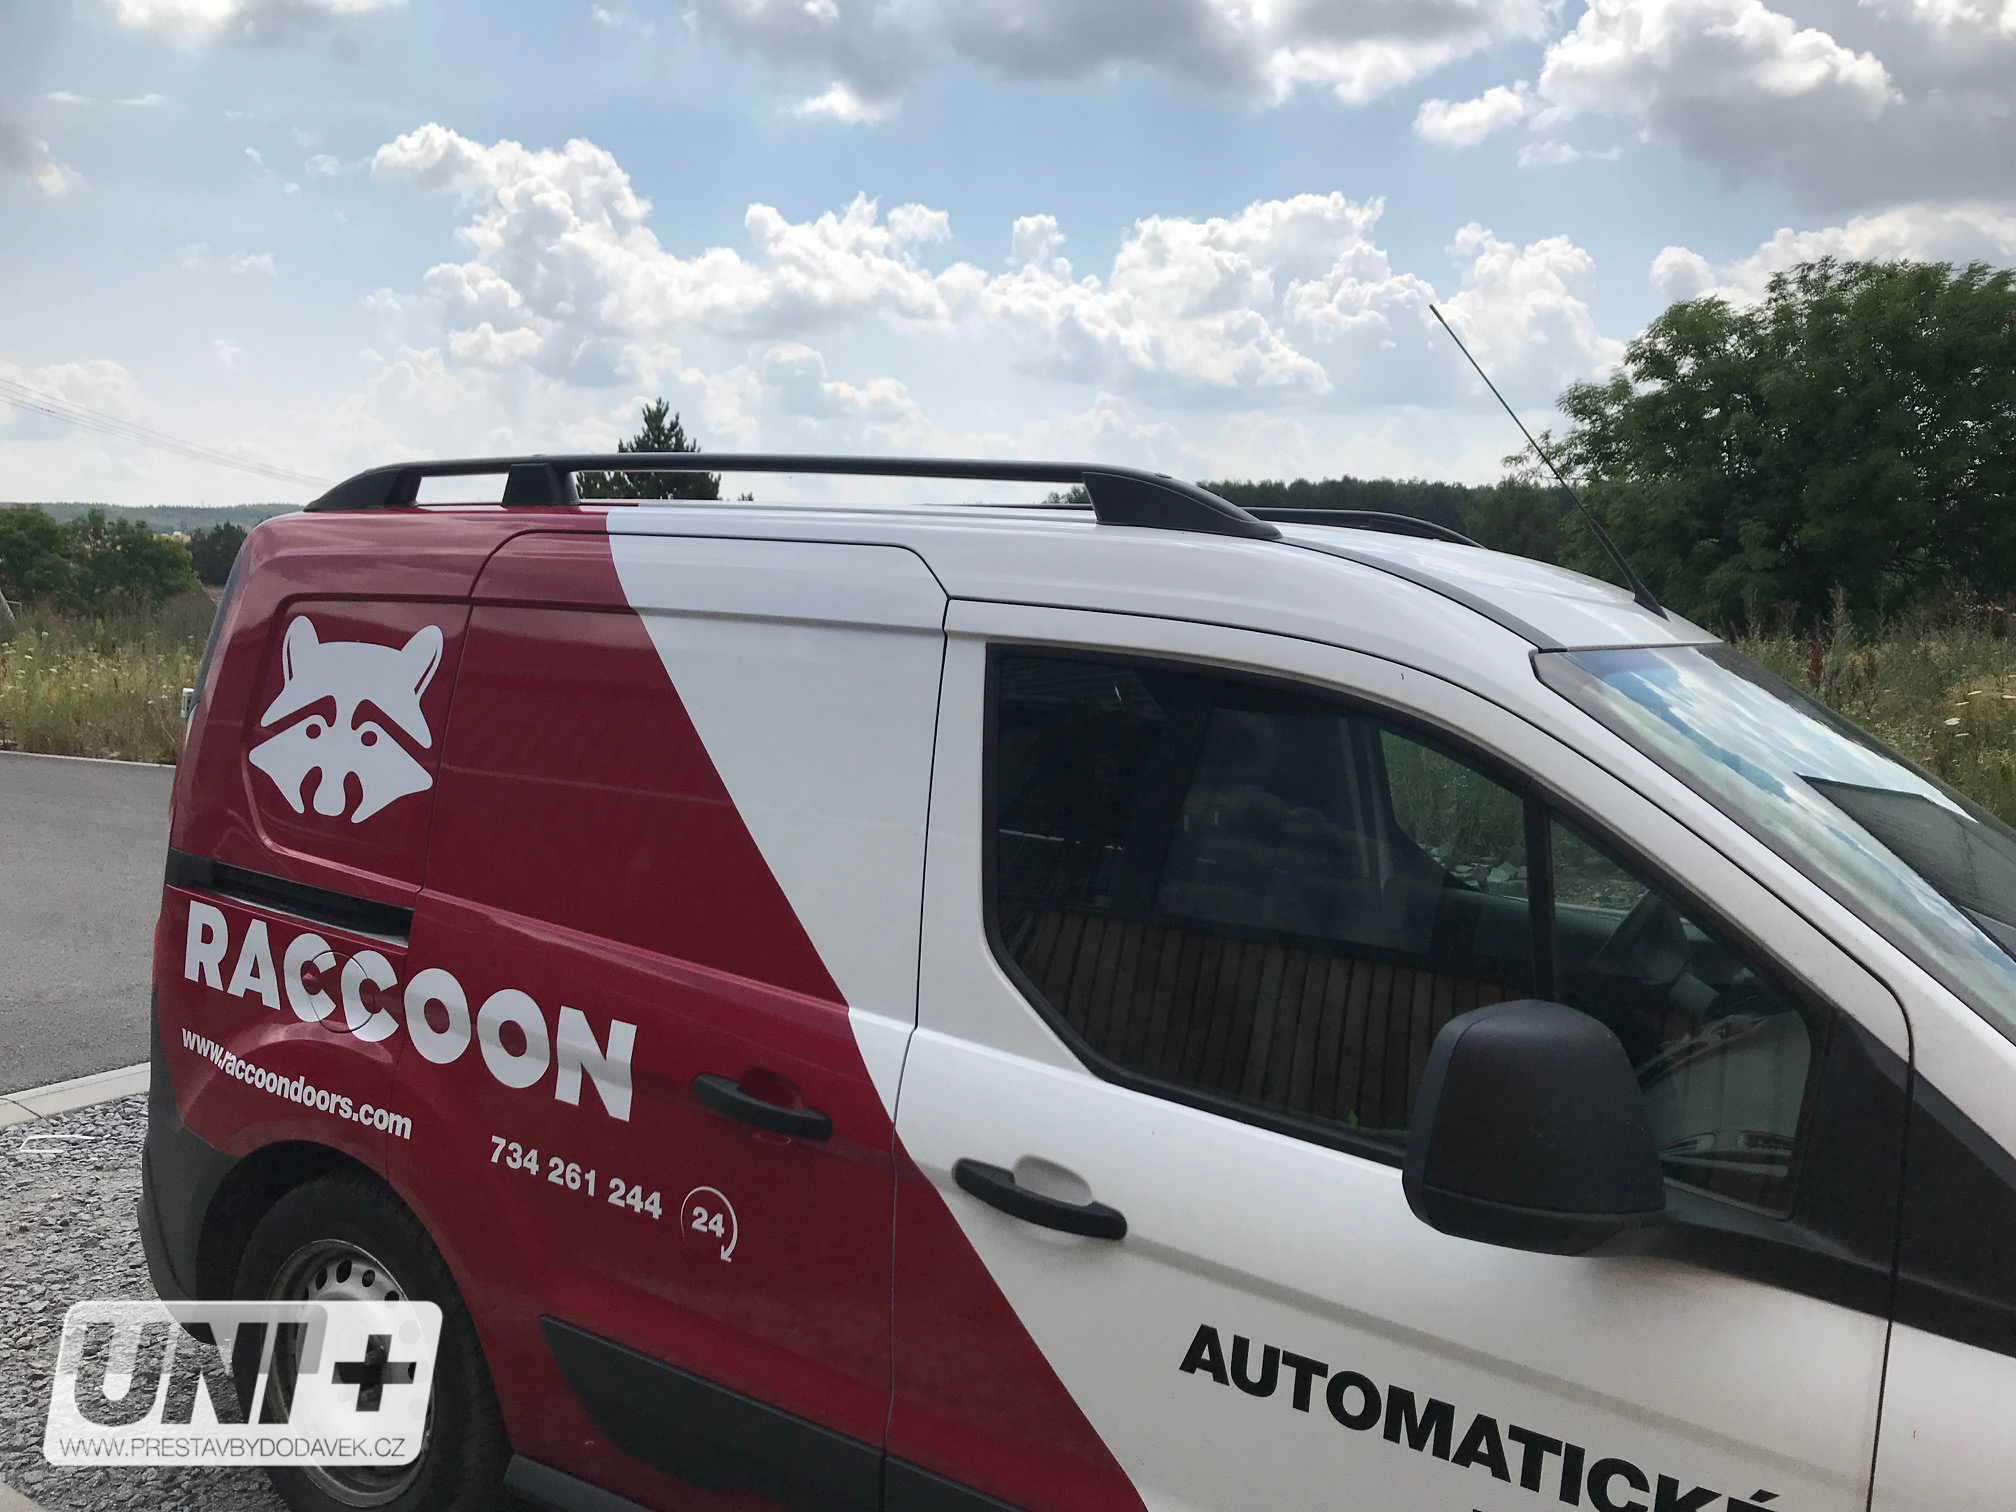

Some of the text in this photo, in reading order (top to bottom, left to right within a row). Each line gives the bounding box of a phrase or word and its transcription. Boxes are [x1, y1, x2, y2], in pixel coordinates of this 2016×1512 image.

[184, 901, 637, 1121] RACCOON
[181, 1028, 412, 1139] www.raccoondoors.com
[490, 1135, 662, 1219] 734 261 244
[691, 1206, 725, 1237] 24
